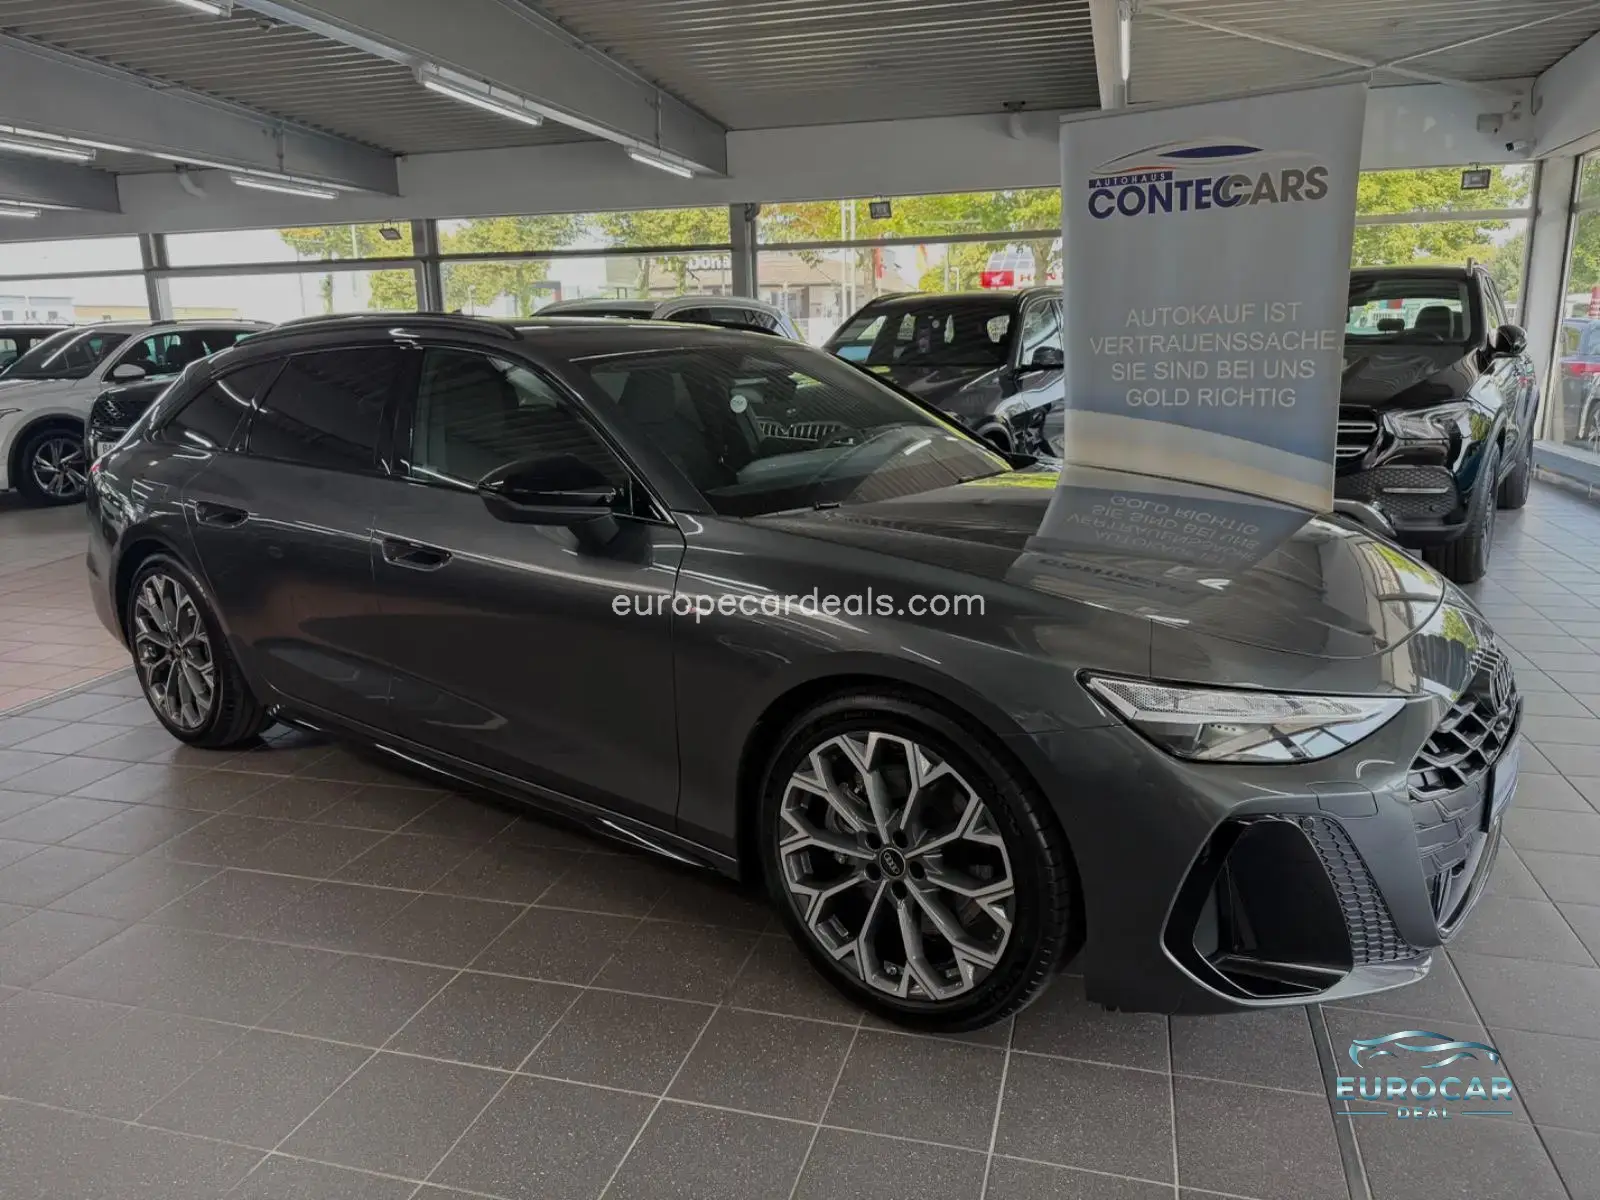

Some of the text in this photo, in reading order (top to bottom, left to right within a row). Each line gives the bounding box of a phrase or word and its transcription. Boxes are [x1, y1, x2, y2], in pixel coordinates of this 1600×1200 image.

[1095, 172, 1166, 187] AUTOHAUS
[1125, 302, 1302, 327] AUTOKAUF IST
[1111, 359, 1315, 381] SIE SIND BEI UNS
[1125, 387, 1296, 407] GOLD RICHTIG
